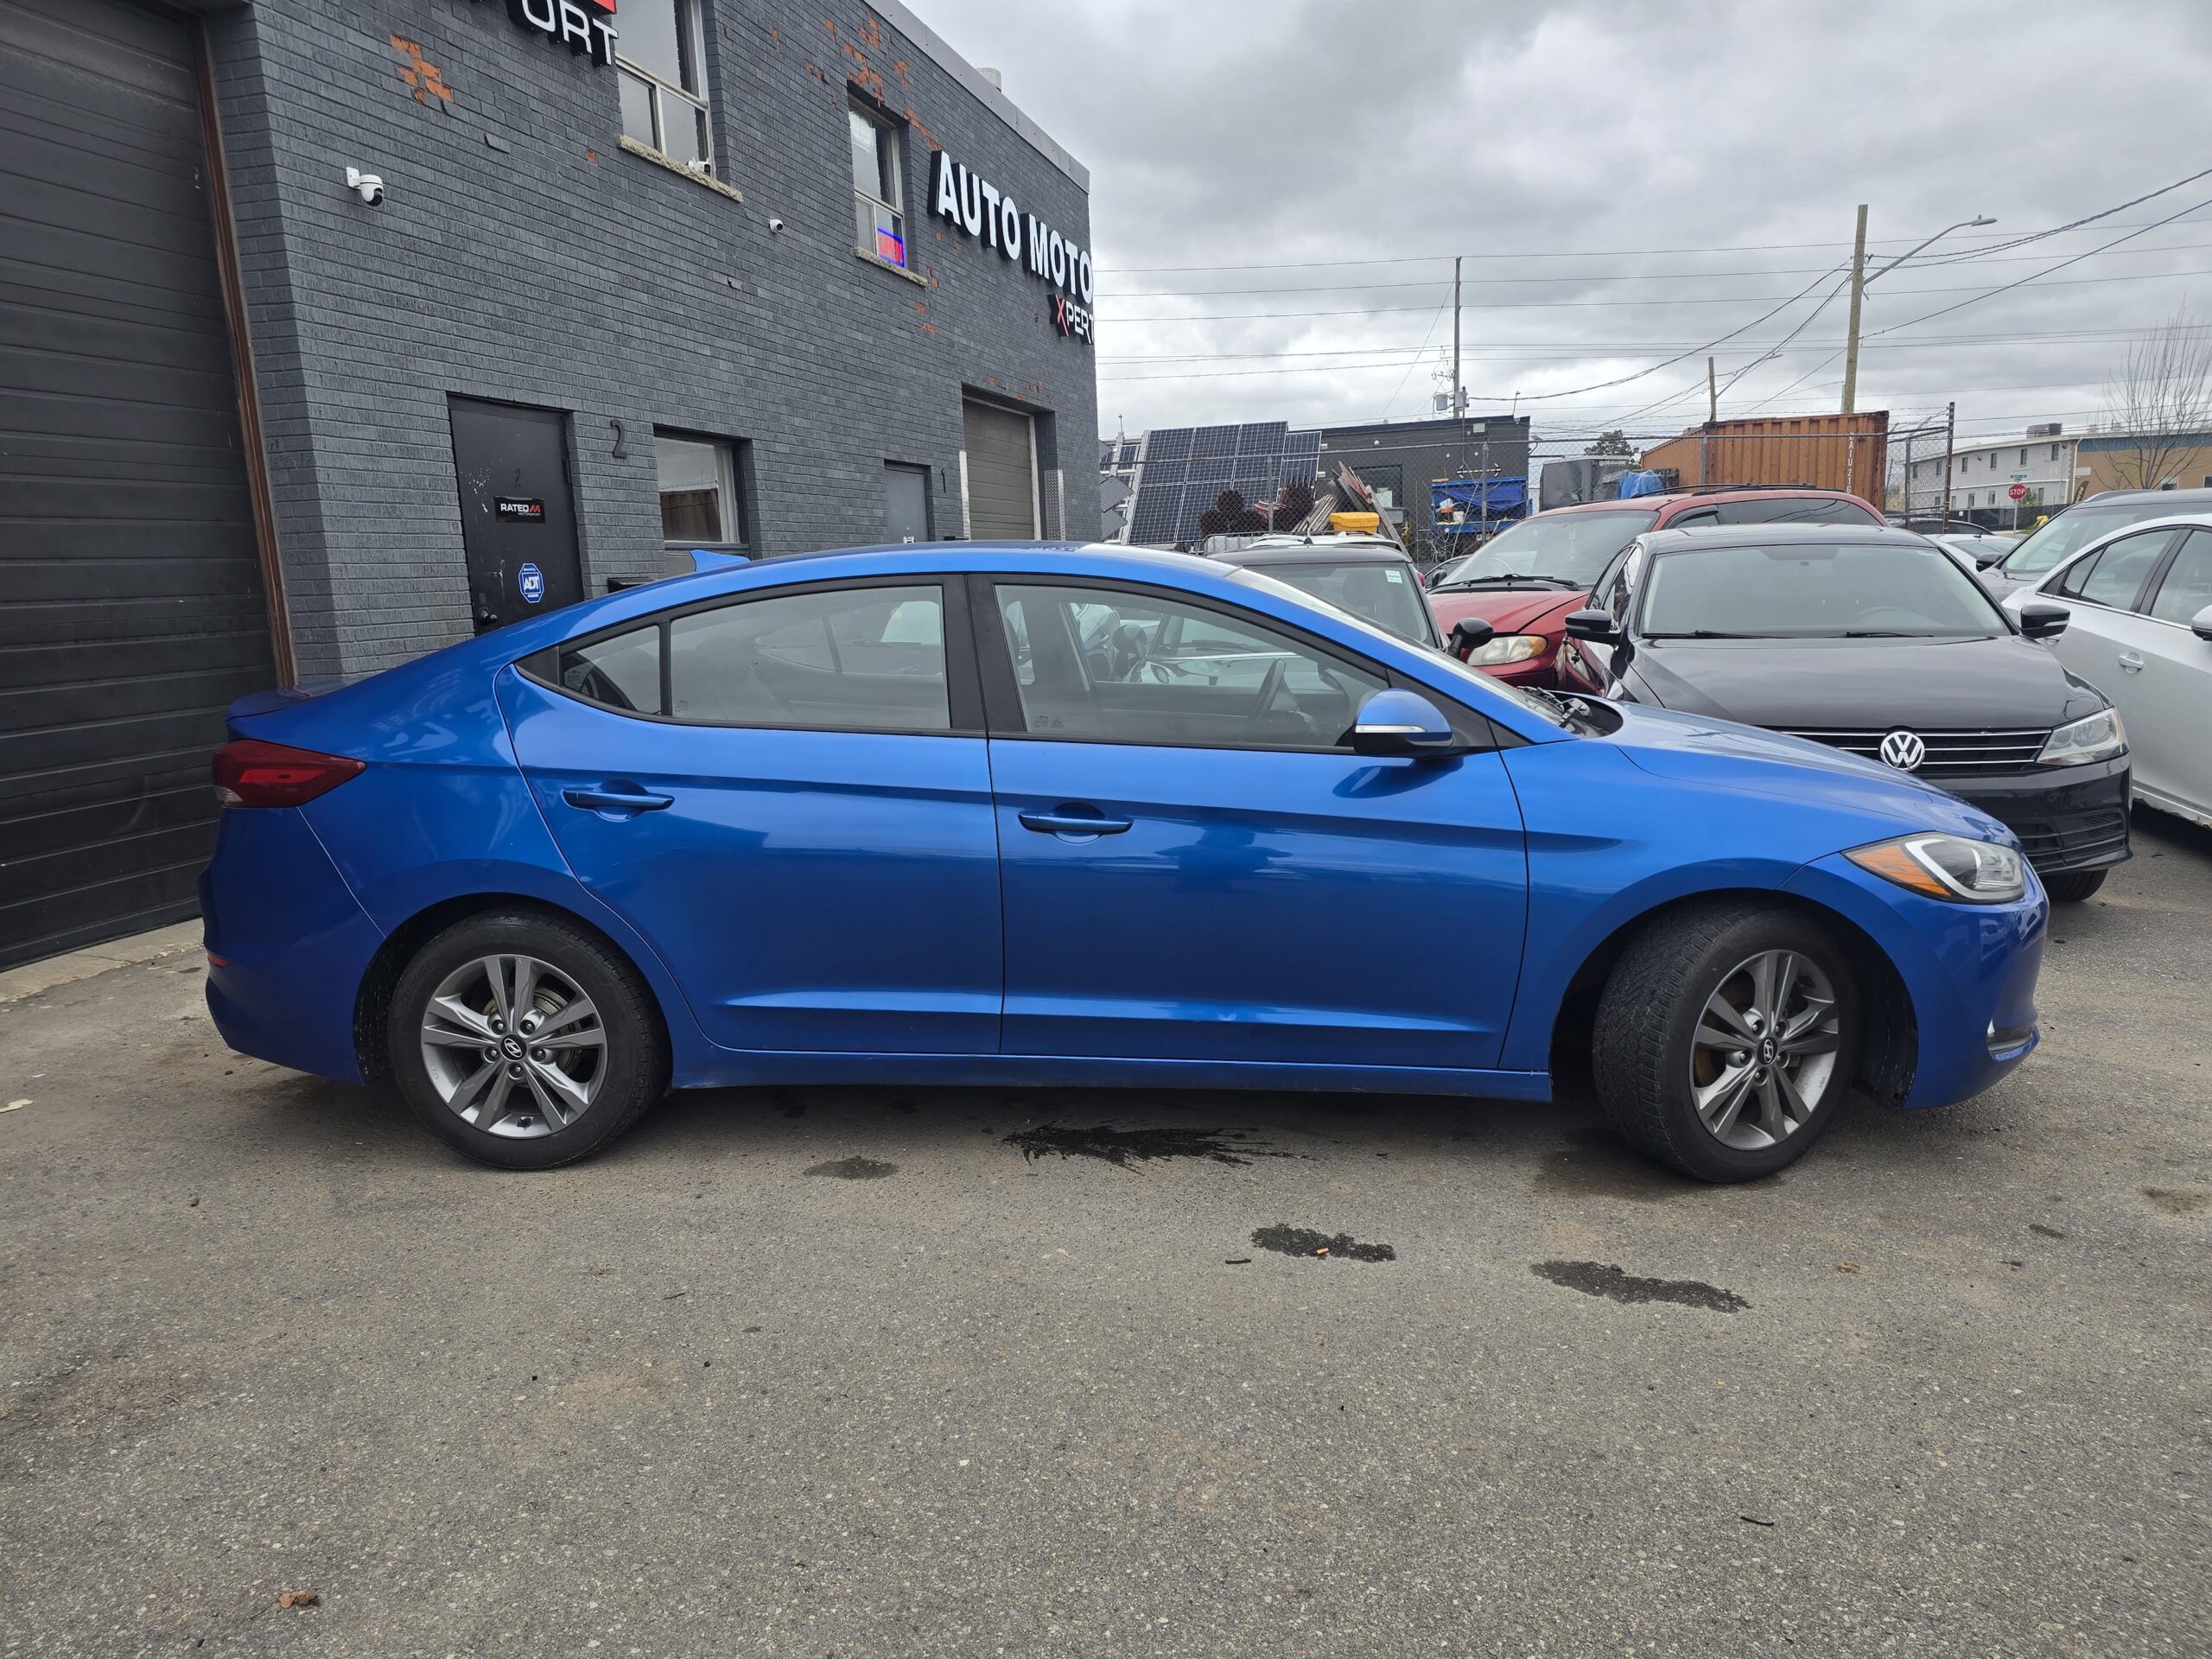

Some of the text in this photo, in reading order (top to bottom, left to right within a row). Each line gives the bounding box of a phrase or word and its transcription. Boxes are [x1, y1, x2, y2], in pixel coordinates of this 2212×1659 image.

[938, 150, 1094, 303] AUTO MOTO
[878, 232, 902, 263] OPEN
[1055, 294, 1095, 344] XPERT
[610, 419, 627, 459] 2
[515, 467, 521, 488] 2
[500, 503, 529, 512] RATED
[524, 575, 539, 590] ADT
